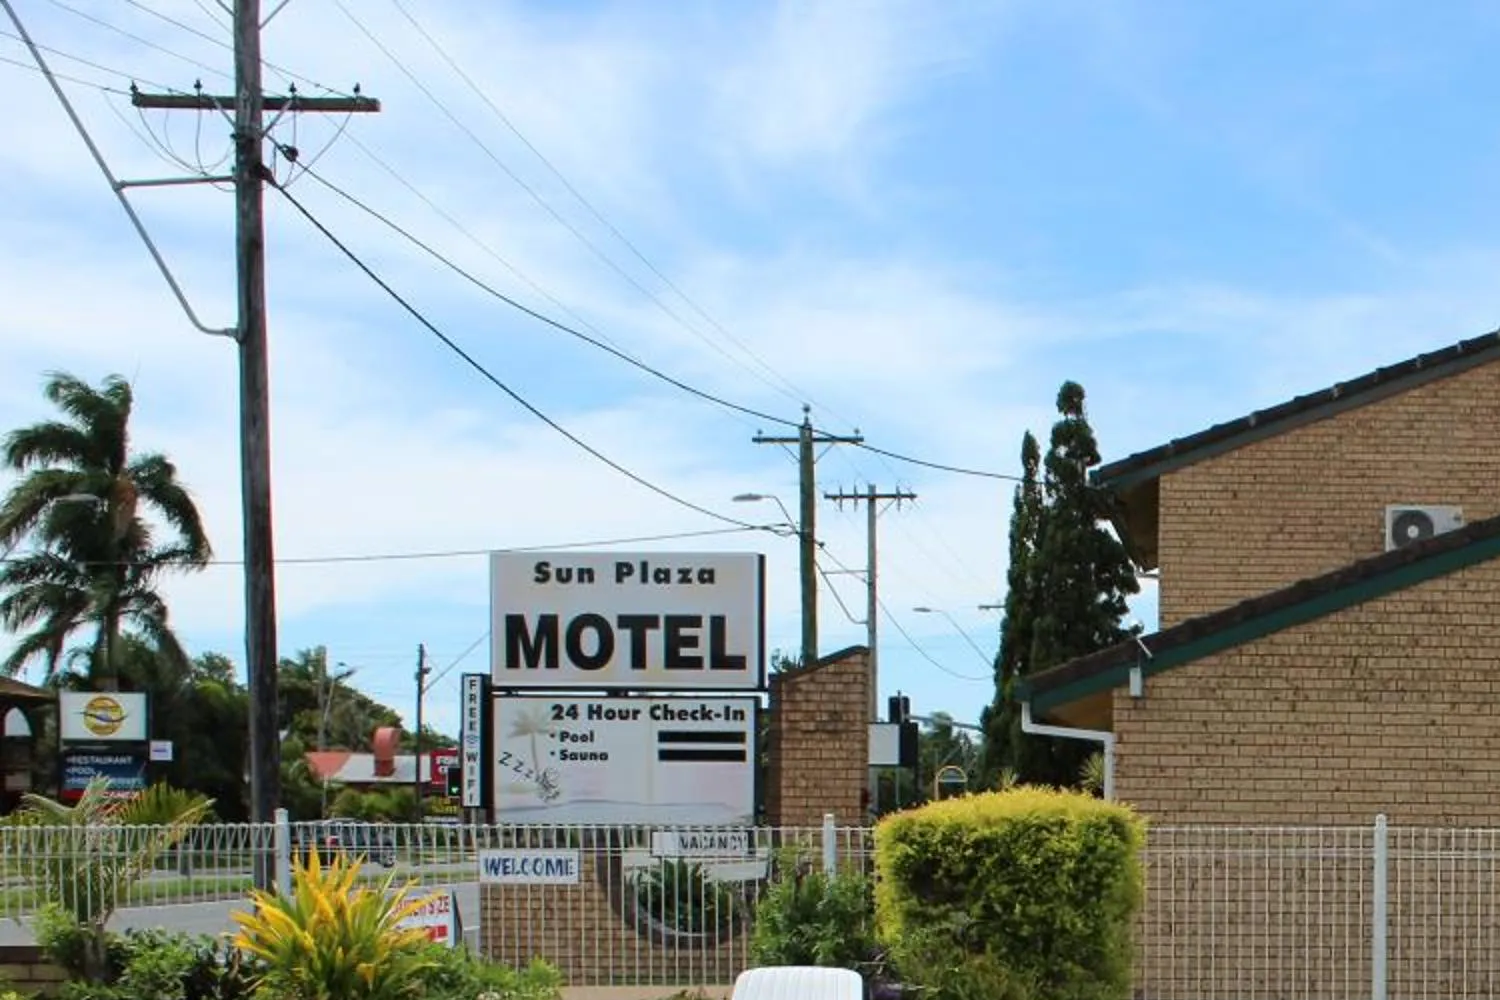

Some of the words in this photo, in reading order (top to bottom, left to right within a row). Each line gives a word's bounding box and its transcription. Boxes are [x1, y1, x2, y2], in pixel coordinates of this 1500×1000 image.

[533, 561, 595, 585] Sun
[615, 561, 716, 585] Plaza
[505, 613, 747, 670] MOTEL
[468, 679, 477, 731] FREE
[552, 704, 579, 721] 24
[587, 704, 641, 721] Hour
[649, 704, 746, 721] Check-In
[560, 730, 595, 743] Pool
[560, 750, 609, 761] Sauna
[484, 857, 575, 876] WELCOME
